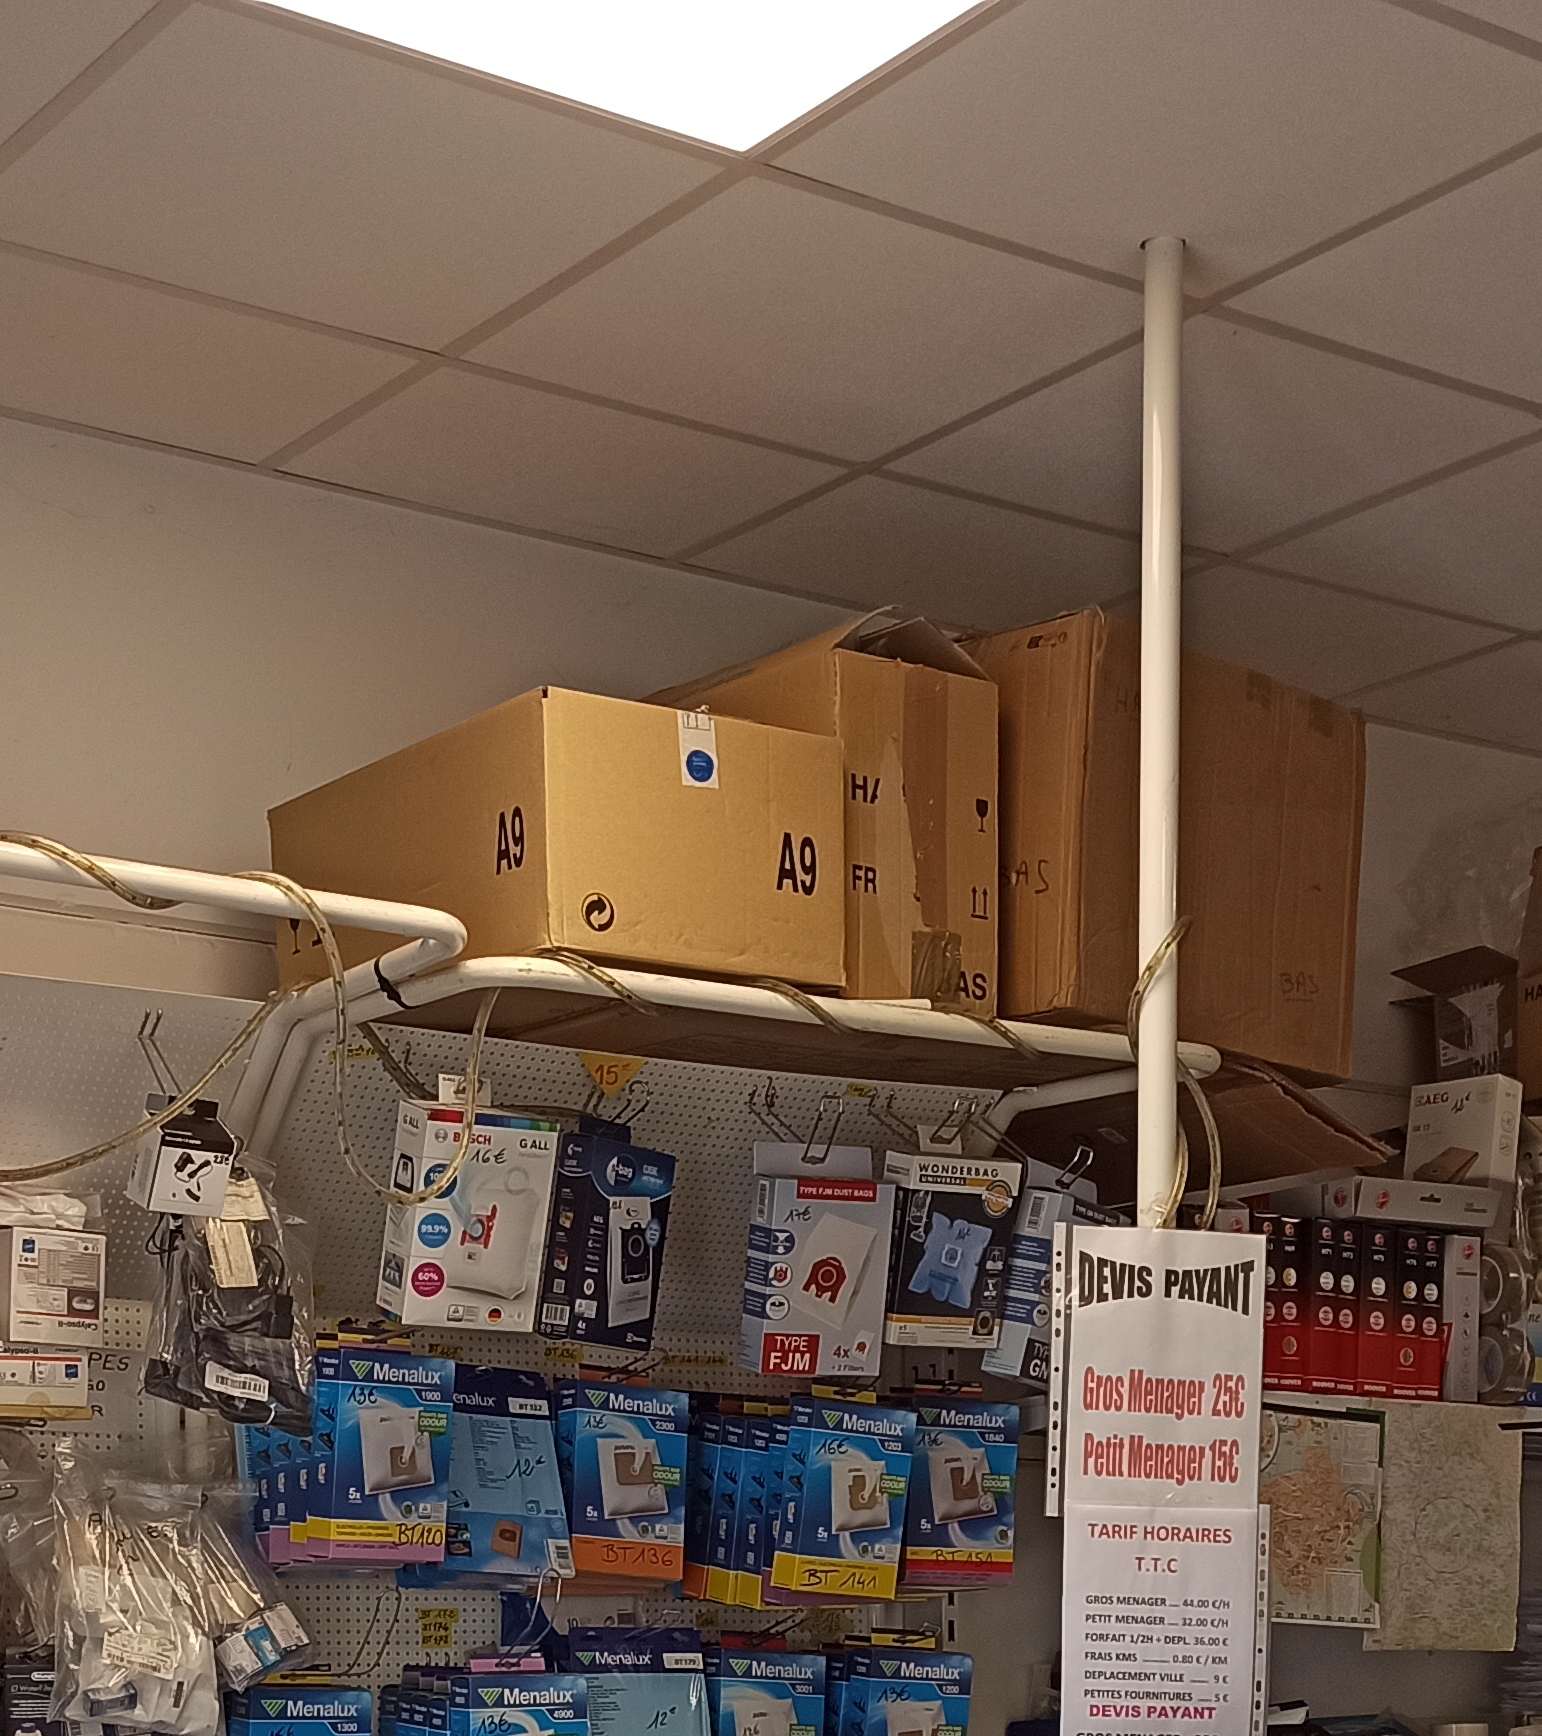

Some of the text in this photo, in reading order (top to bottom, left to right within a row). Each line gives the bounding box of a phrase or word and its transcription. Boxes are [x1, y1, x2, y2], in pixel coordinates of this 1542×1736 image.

[495, 805, 525, 875] A9
[777, 832, 818, 896] A9
[918, 1163, 999, 1178] WONDERBAG
[1079, 1250, 1255, 1316] DEVIS PAYANT
[774, 1336, 808, 1350] TYPE
[769, 1353, 810, 1371] FJM
[374, 1363, 441, 1401] Menalux 1900
[1083, 1366, 1245, 1420] Gros Menager 25€
[609, 1393, 678, 1416] Menalux
[1083, 1432, 1239, 1486] Petit Menager 15€
[1088, 1523, 1232, 1544] TARIF HORAIRES
[1135, 1557, 1178, 1573] T.T.C
[1086, 1595, 1230, 1609] GROS MENAGER 44.00 €/H
[1085, 1614, 1229, 1628] PETIT MENAGER 32.00 €/H
[1085, 1633, 1126, 1642] FORFAIT
[1130, 1634, 1153, 1644] 1/2H
[1193, 1637, 1220, 1646] 36.00
[595, 1651, 652, 1666] Menalux
[1084, 1652, 1228, 1665] FRAIS KMS 0.80 KM
[1084, 1671, 1184, 1682] DEPLACEMENT VILLE
[504, 1687, 573, 1706] Menalux
[1084, 1689, 1193, 1701] PETITES FOURNITURES
[287, 1699, 358, 1718] Menalux
[1089, 1705, 1216, 1719] DEVIS PAYANT
